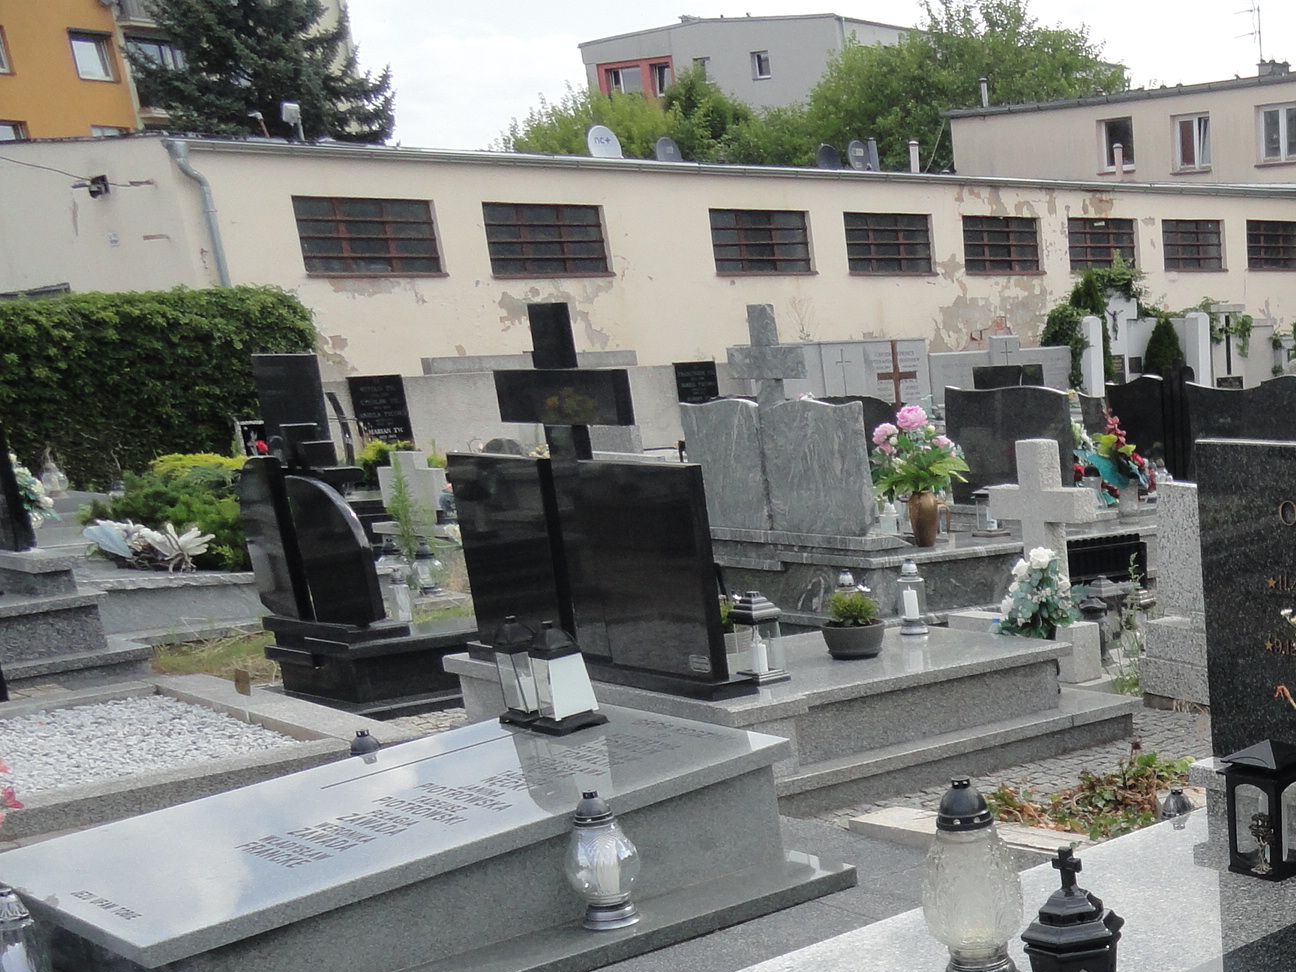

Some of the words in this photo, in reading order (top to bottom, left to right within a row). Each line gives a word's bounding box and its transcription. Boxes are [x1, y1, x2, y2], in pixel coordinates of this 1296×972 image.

[594, 137, 611, 145] nc+
[413, 782, 513, 812] PIOTROWSKA
[372, 796, 469, 826] PIOTROWSKI
[336, 812, 407, 837] ZAWADA
[286, 827, 359, 852] ZAWADA
[234, 841, 312, 868] FRANCKE
